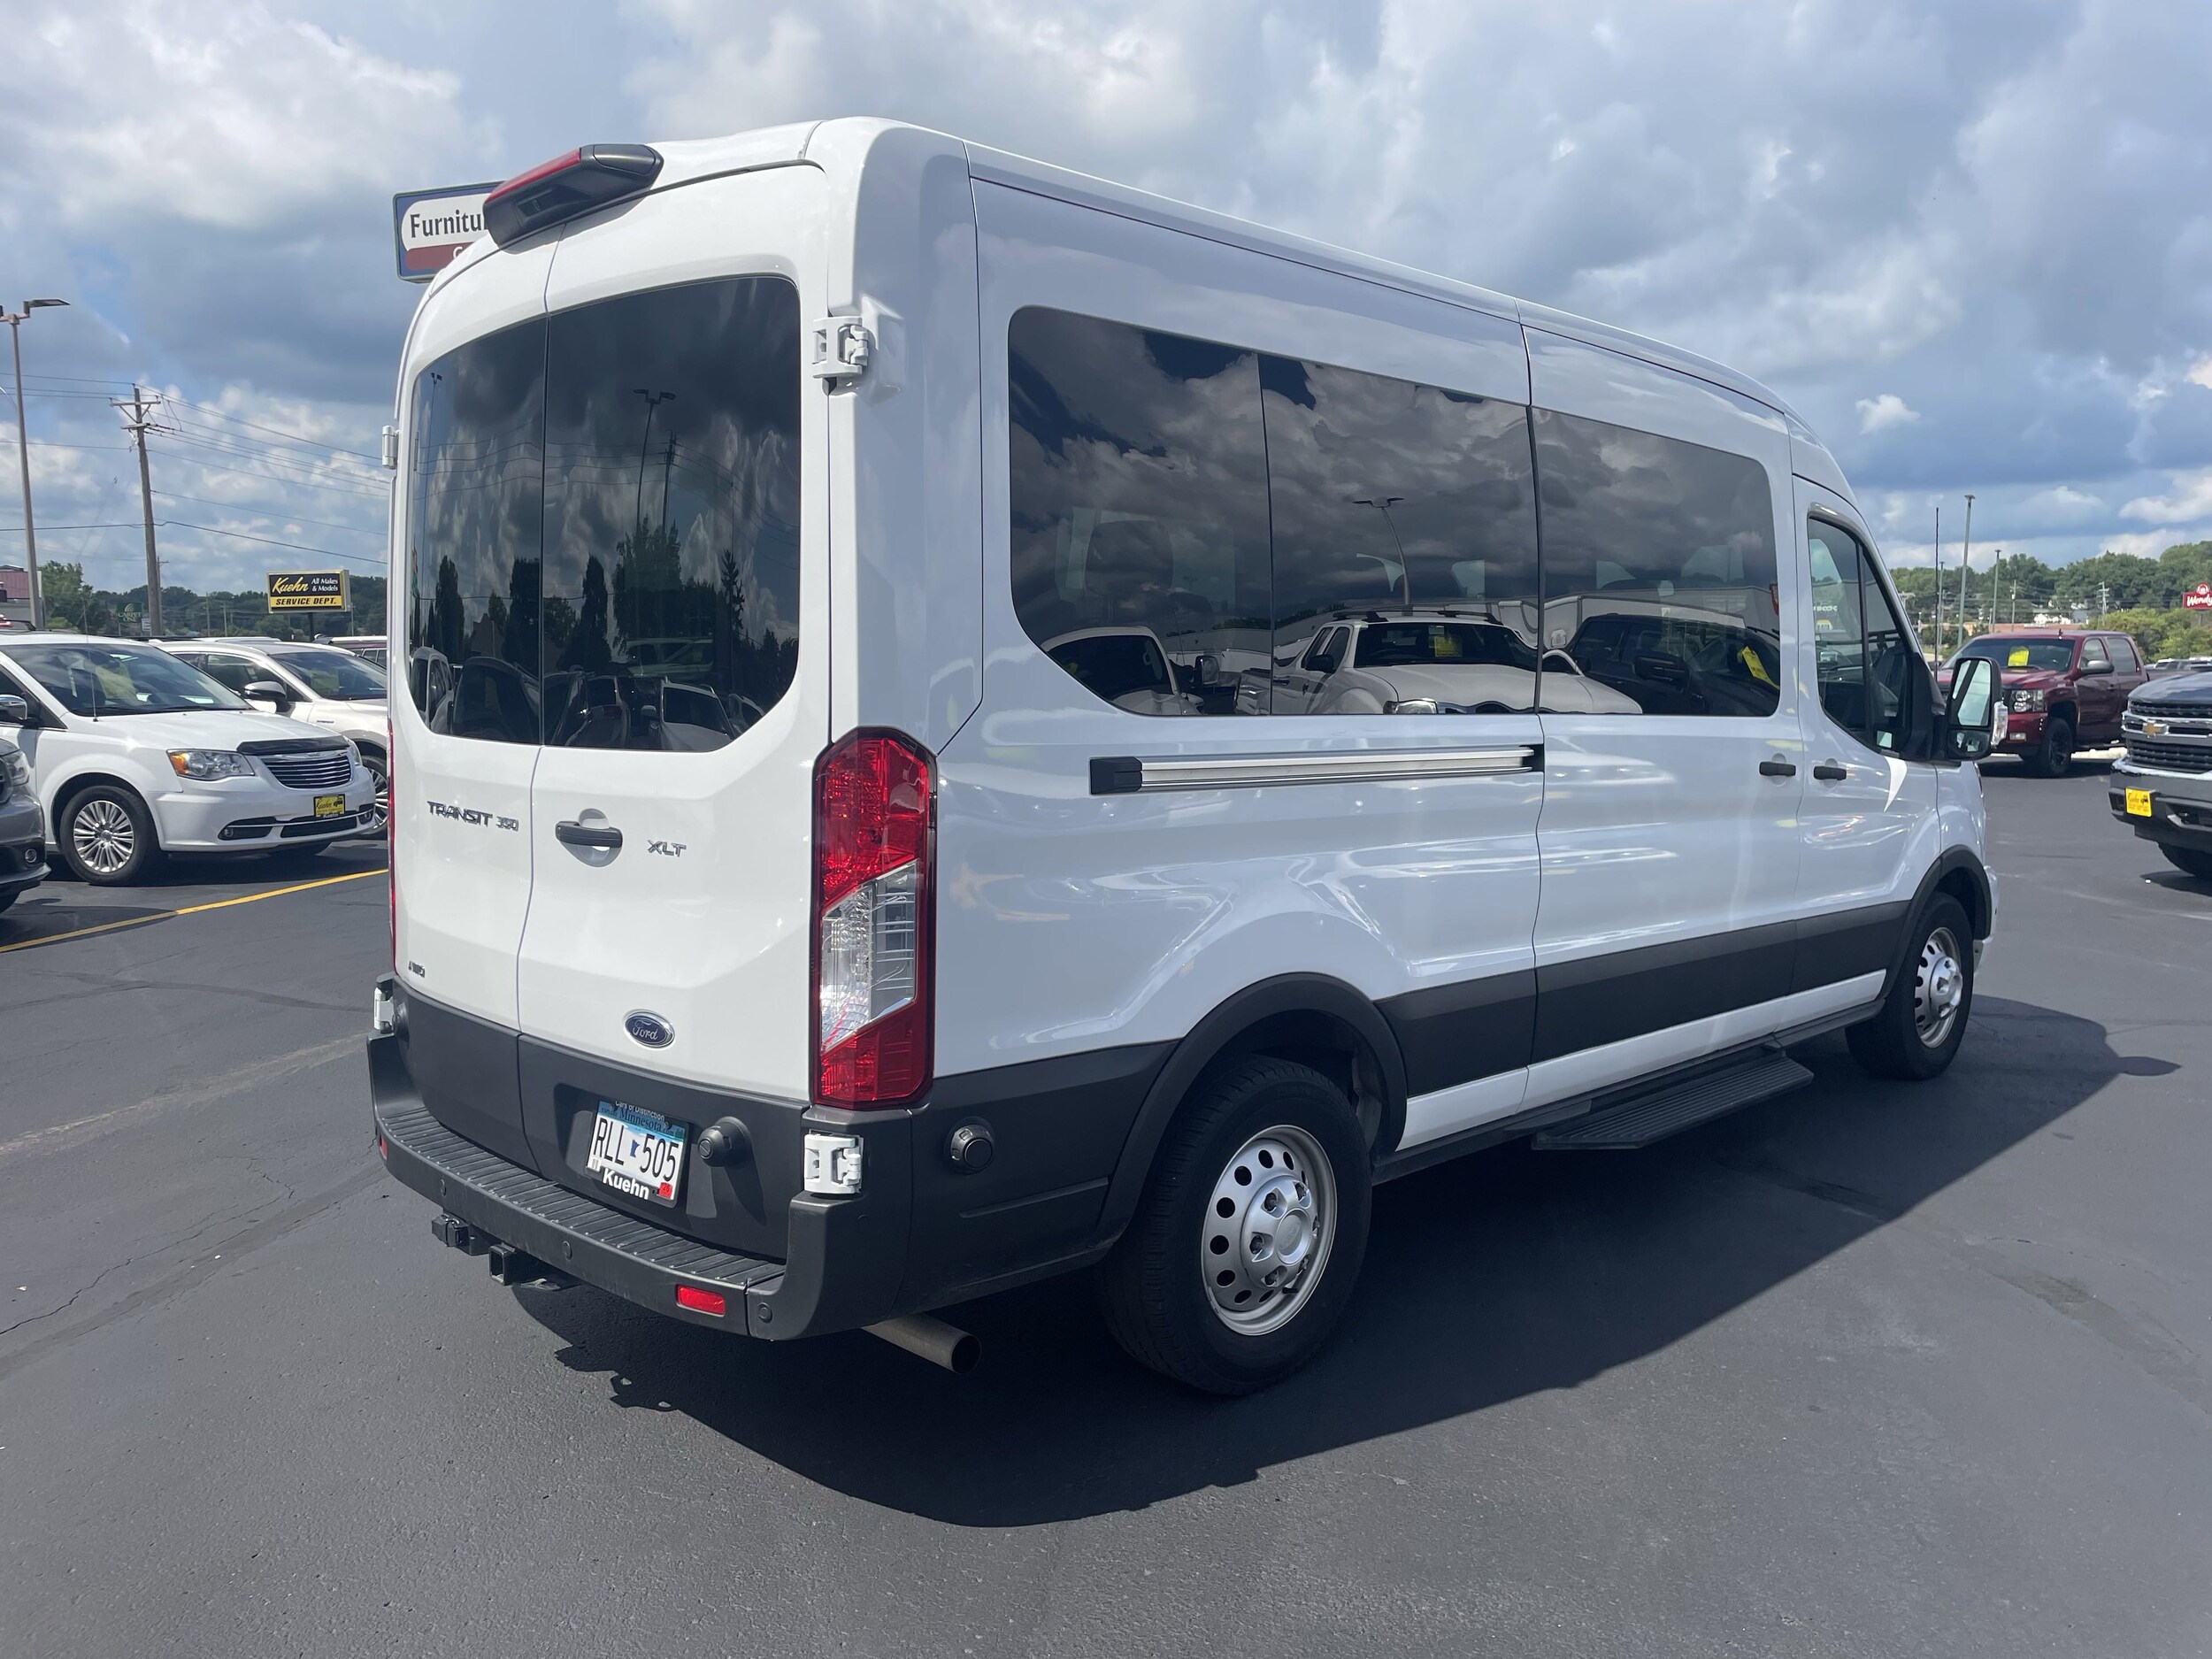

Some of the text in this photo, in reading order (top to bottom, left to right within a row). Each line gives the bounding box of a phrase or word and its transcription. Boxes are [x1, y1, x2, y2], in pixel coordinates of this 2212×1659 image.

[410, 209, 487, 238] Furnitu
[273, 577, 308, 594] Kuehn
[426, 801, 518, 832] TRANSIT 350
[647, 839, 687, 857] XLT
[632, 1018, 658, 1041] Ford
[594, 1118, 679, 1182] RLL 505
[603, 1167, 649, 1201] Kuehn
